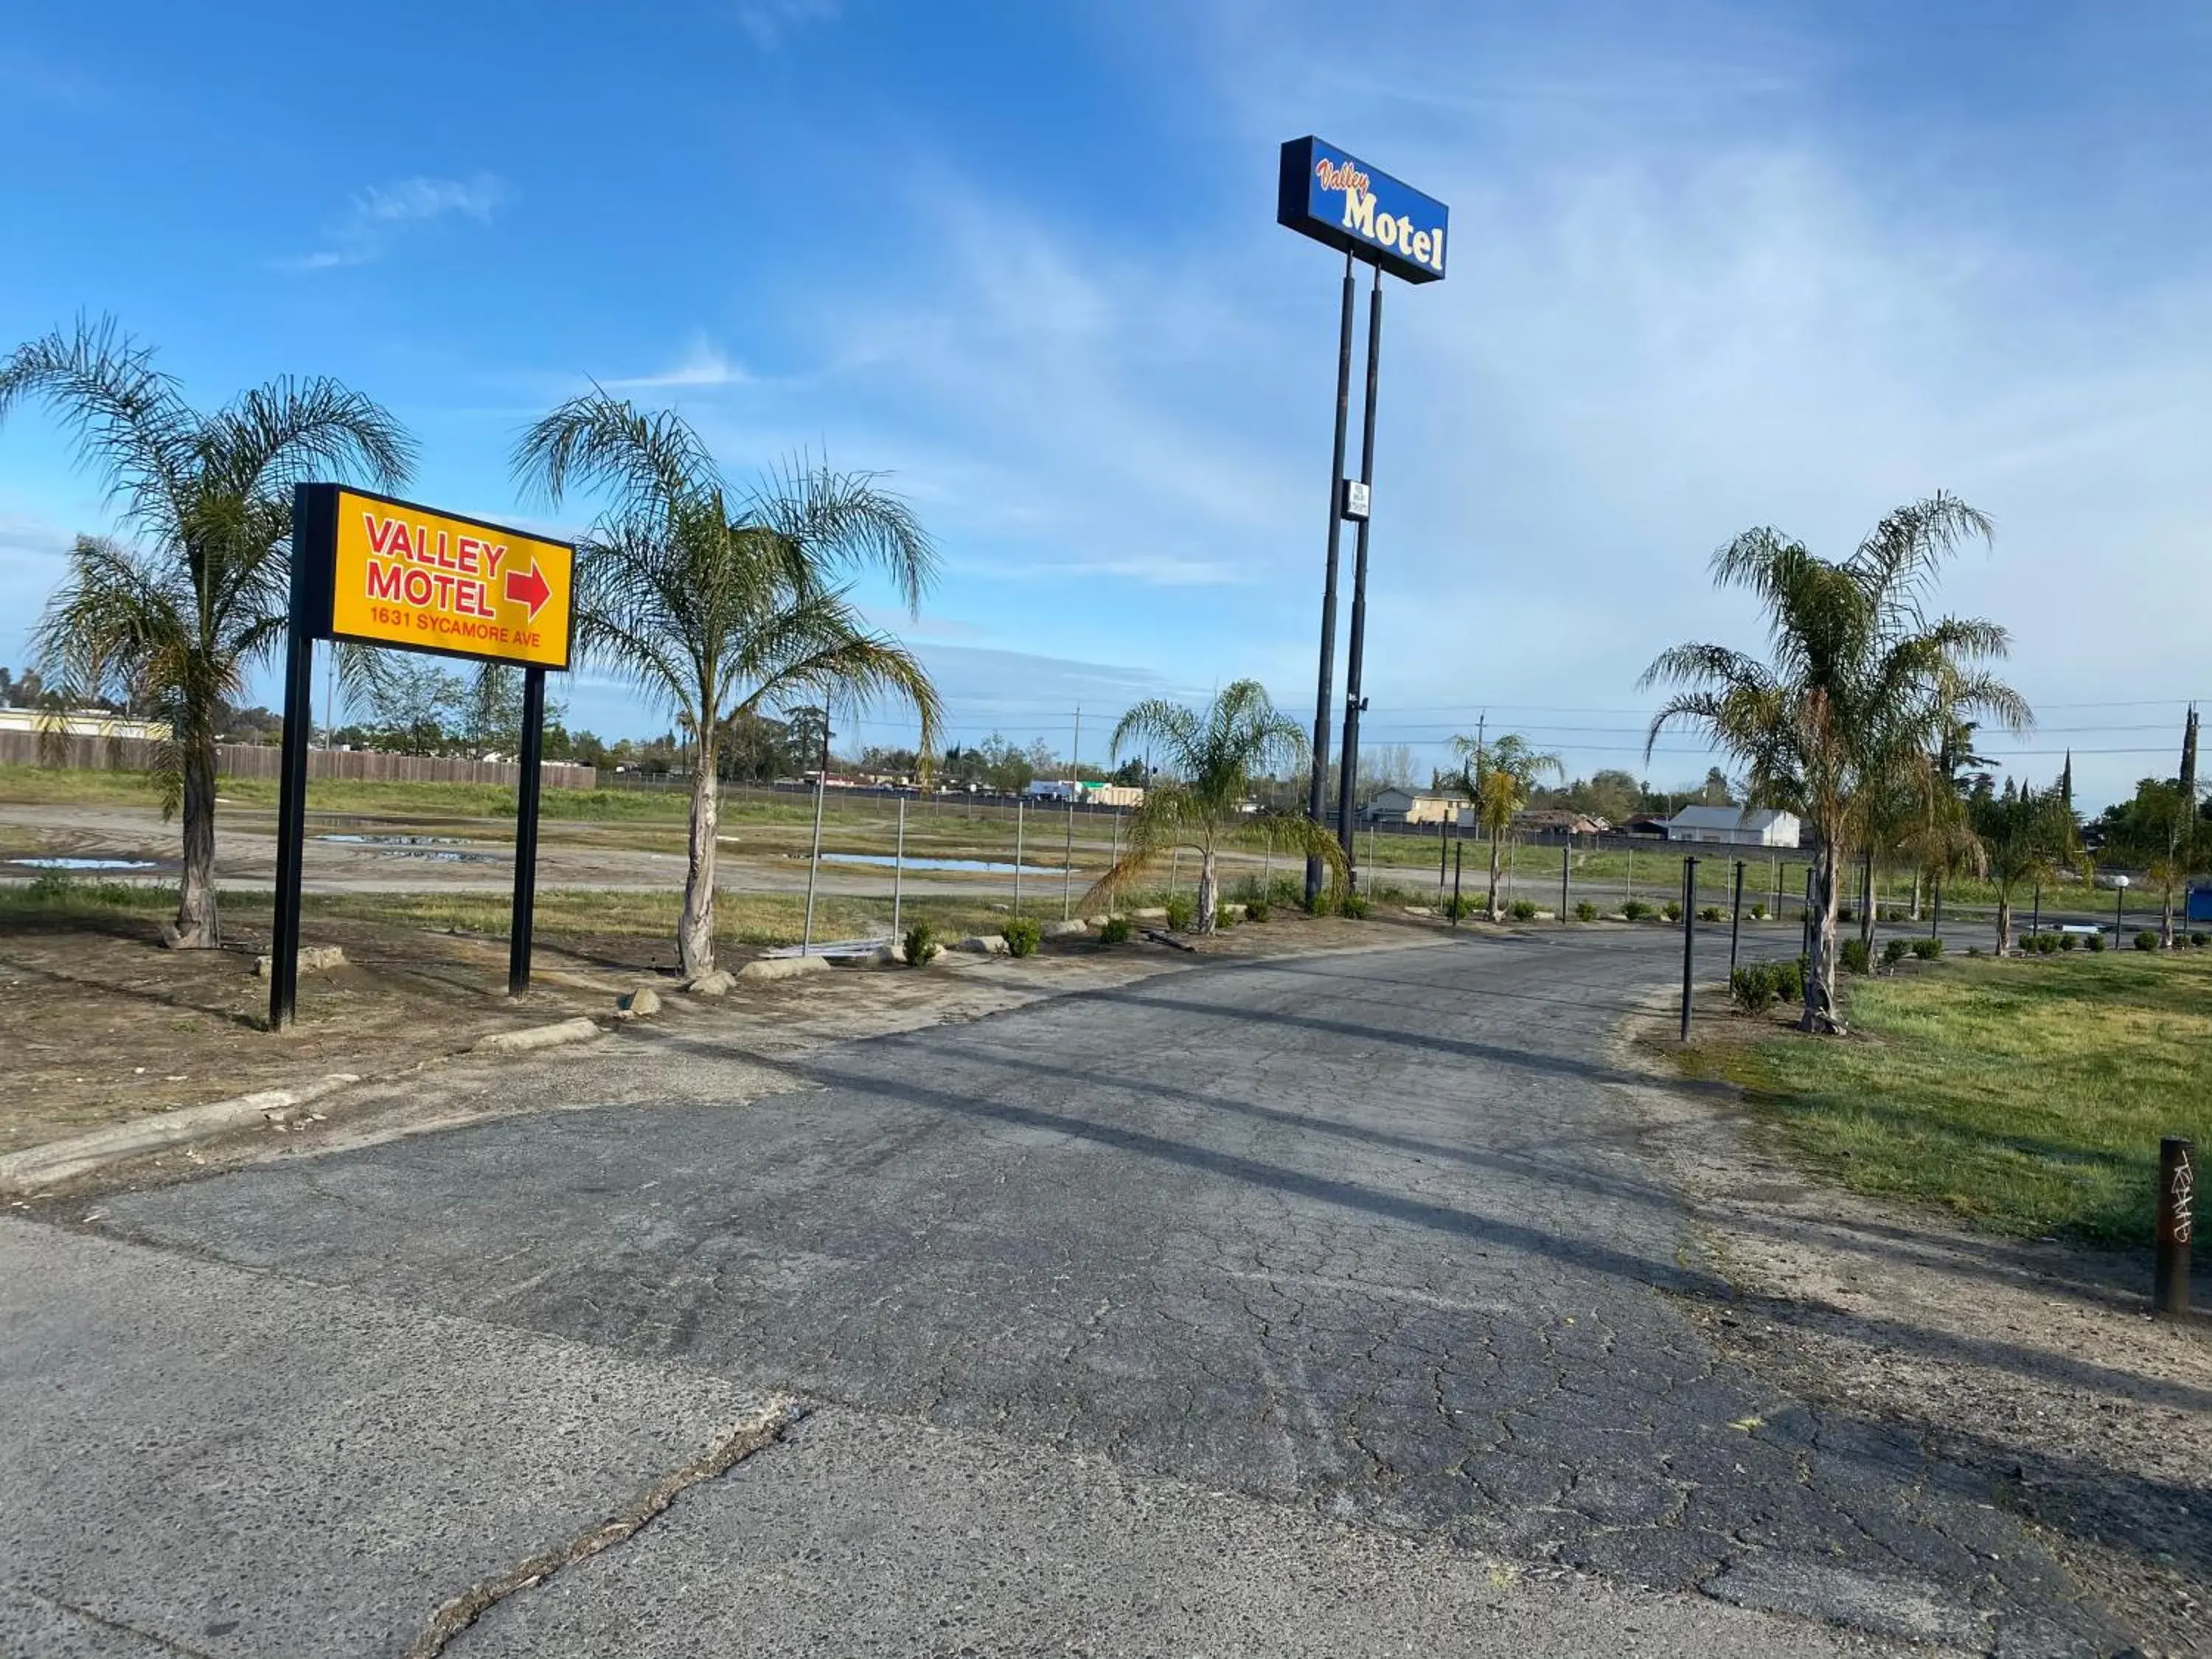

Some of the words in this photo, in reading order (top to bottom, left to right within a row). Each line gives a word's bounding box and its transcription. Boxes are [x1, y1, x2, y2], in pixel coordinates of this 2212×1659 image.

[1316, 159, 1369, 195] Valley
[1343, 186, 1443, 271] Motel
[363, 513, 507, 579] VALLEY
[366, 559, 495, 619] MOTEL
[371, 607, 410, 627] 1631
[417, 613, 508, 641] SYCAMORE
[512, 633, 540, 647] AVE
